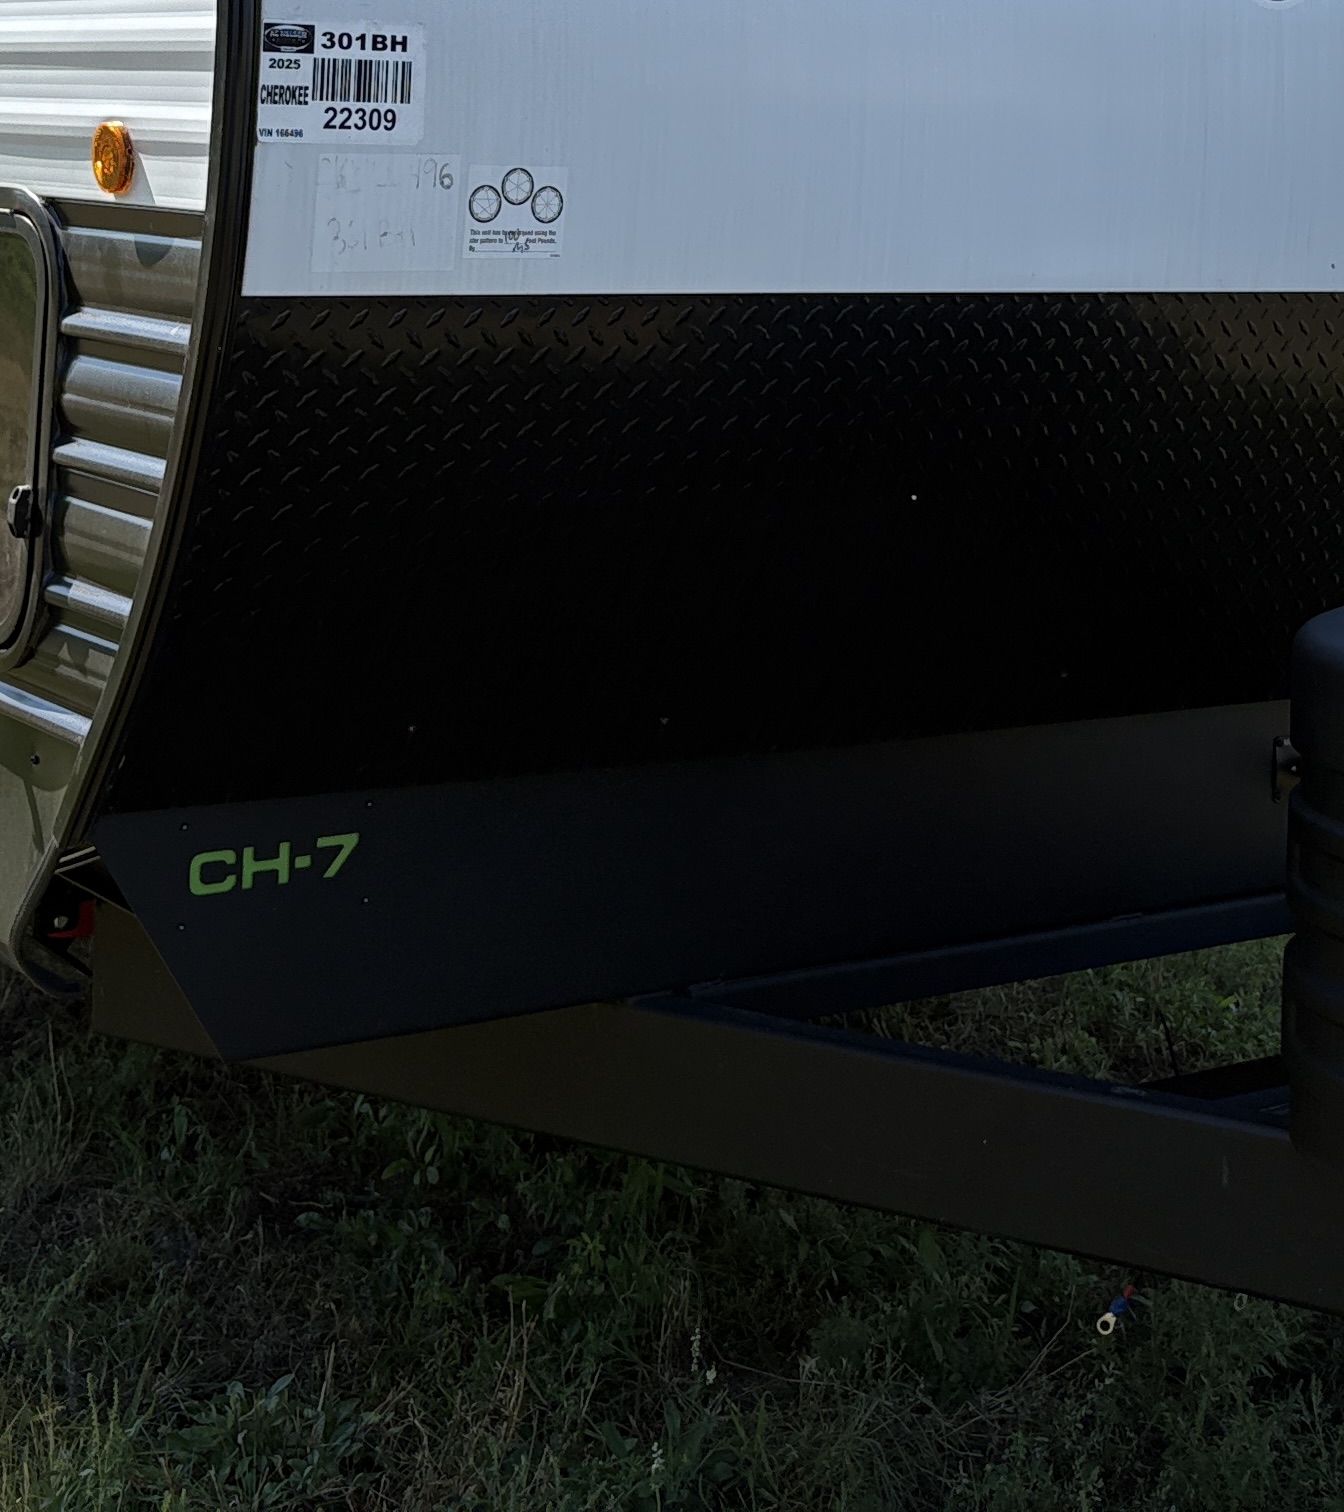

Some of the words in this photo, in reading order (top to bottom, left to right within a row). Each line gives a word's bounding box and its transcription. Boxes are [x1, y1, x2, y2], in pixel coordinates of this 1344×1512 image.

[320, 31, 408, 53] 301BH
[268, 57, 301, 70] 2025
[260, 84, 309, 106] CHEROKEE
[322, 106, 397, 131] 22309
[258, 127, 273, 138] VIN
[189, 832, 360, 896] CH-7
